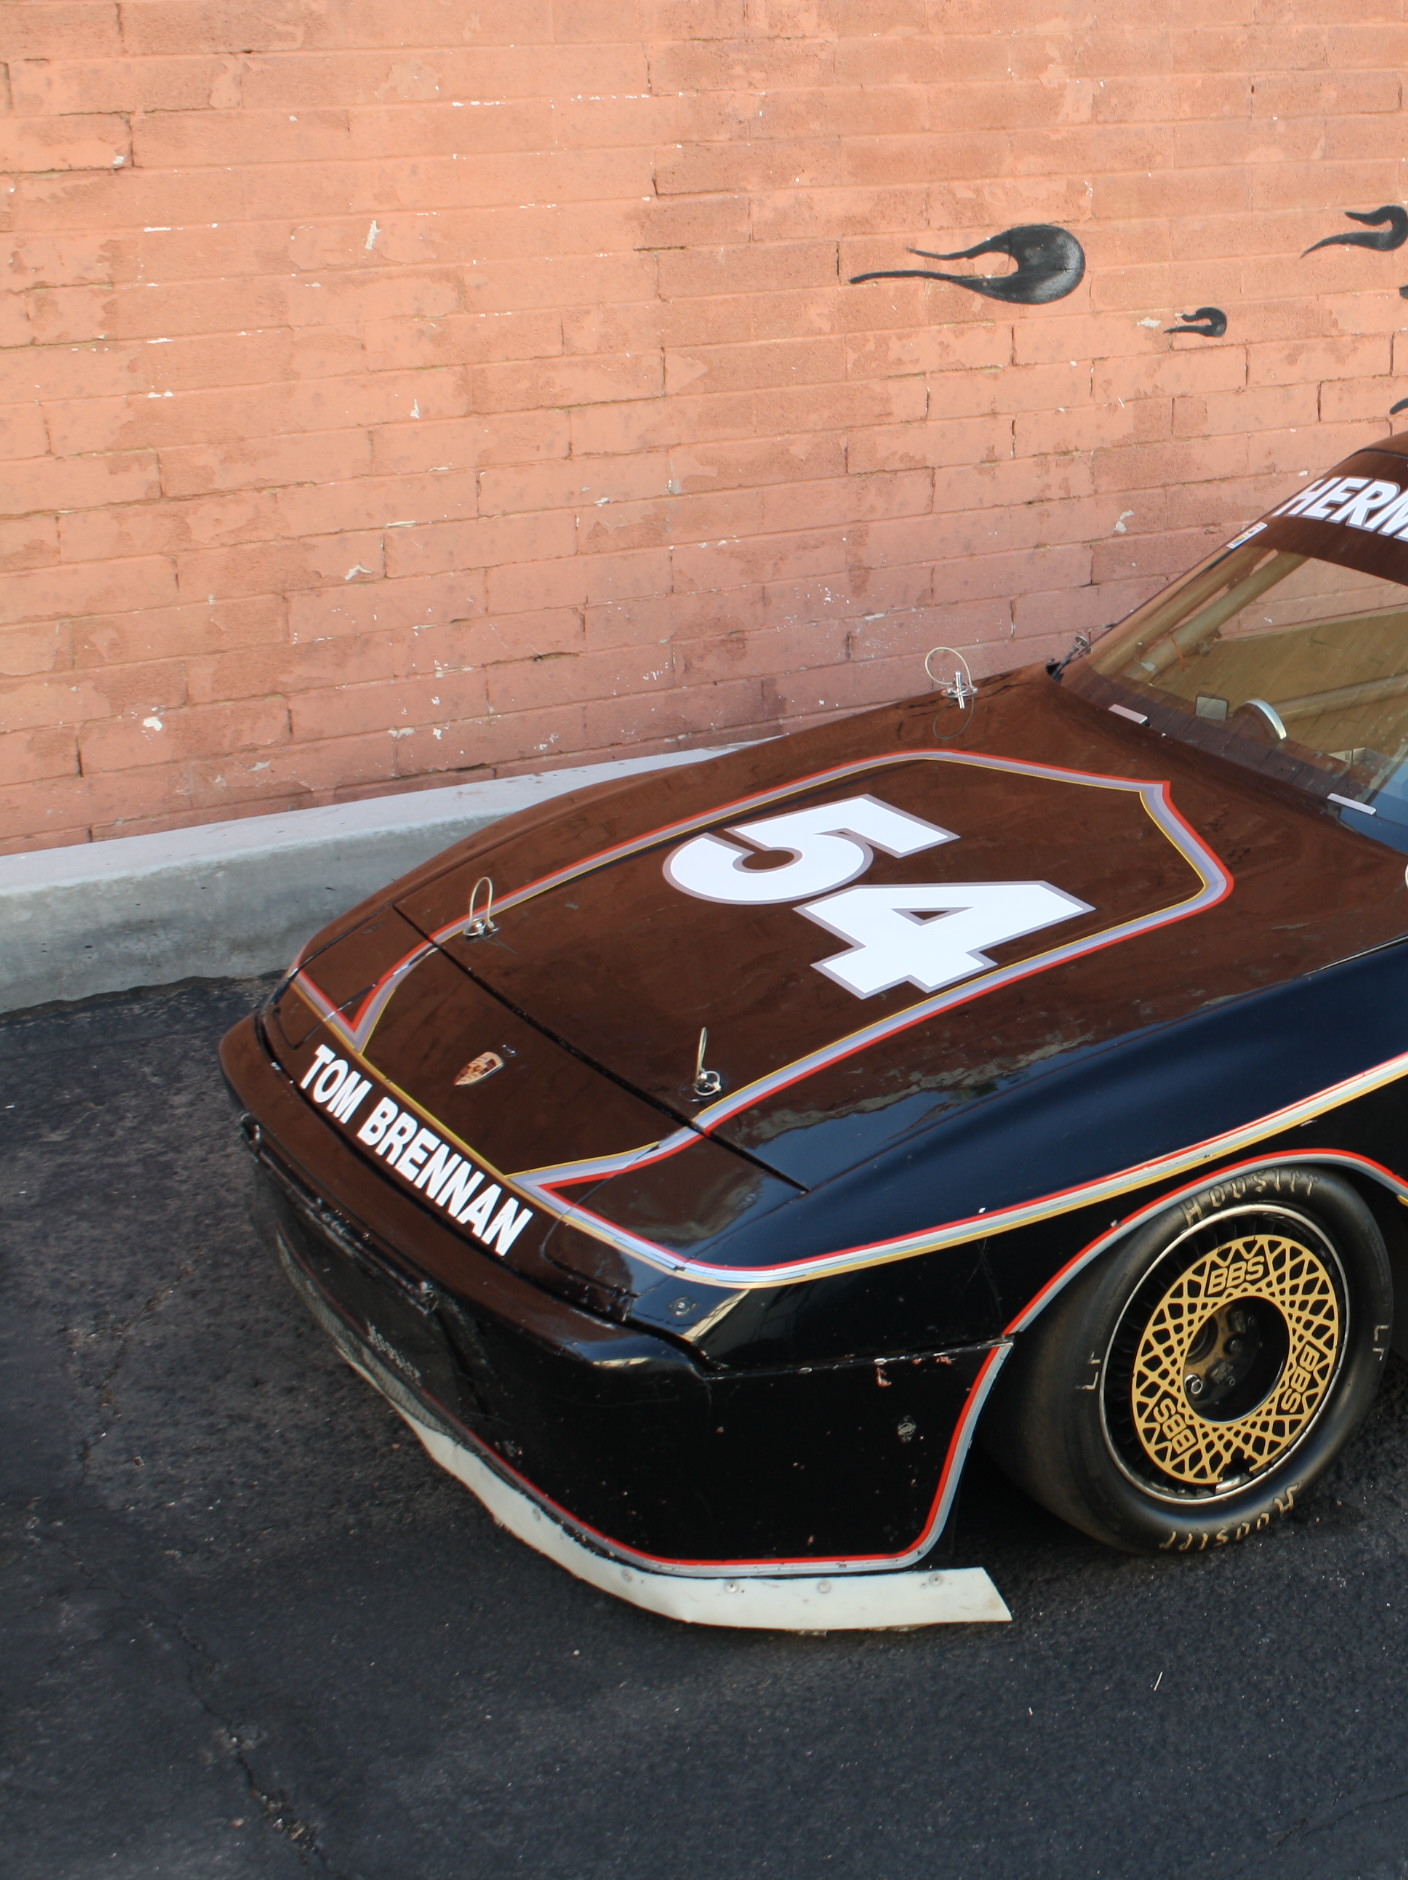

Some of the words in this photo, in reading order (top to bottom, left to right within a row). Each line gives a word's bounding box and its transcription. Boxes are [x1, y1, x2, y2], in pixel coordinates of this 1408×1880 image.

[300, 1044, 373, 1124] TOM
[356, 1097, 534, 1257] BRENNAN
[1207, 1254, 1265, 1297] BBS
[1279, 1343, 1321, 1414] BBS
[1152, 1397, 1199, 1455] BBS
